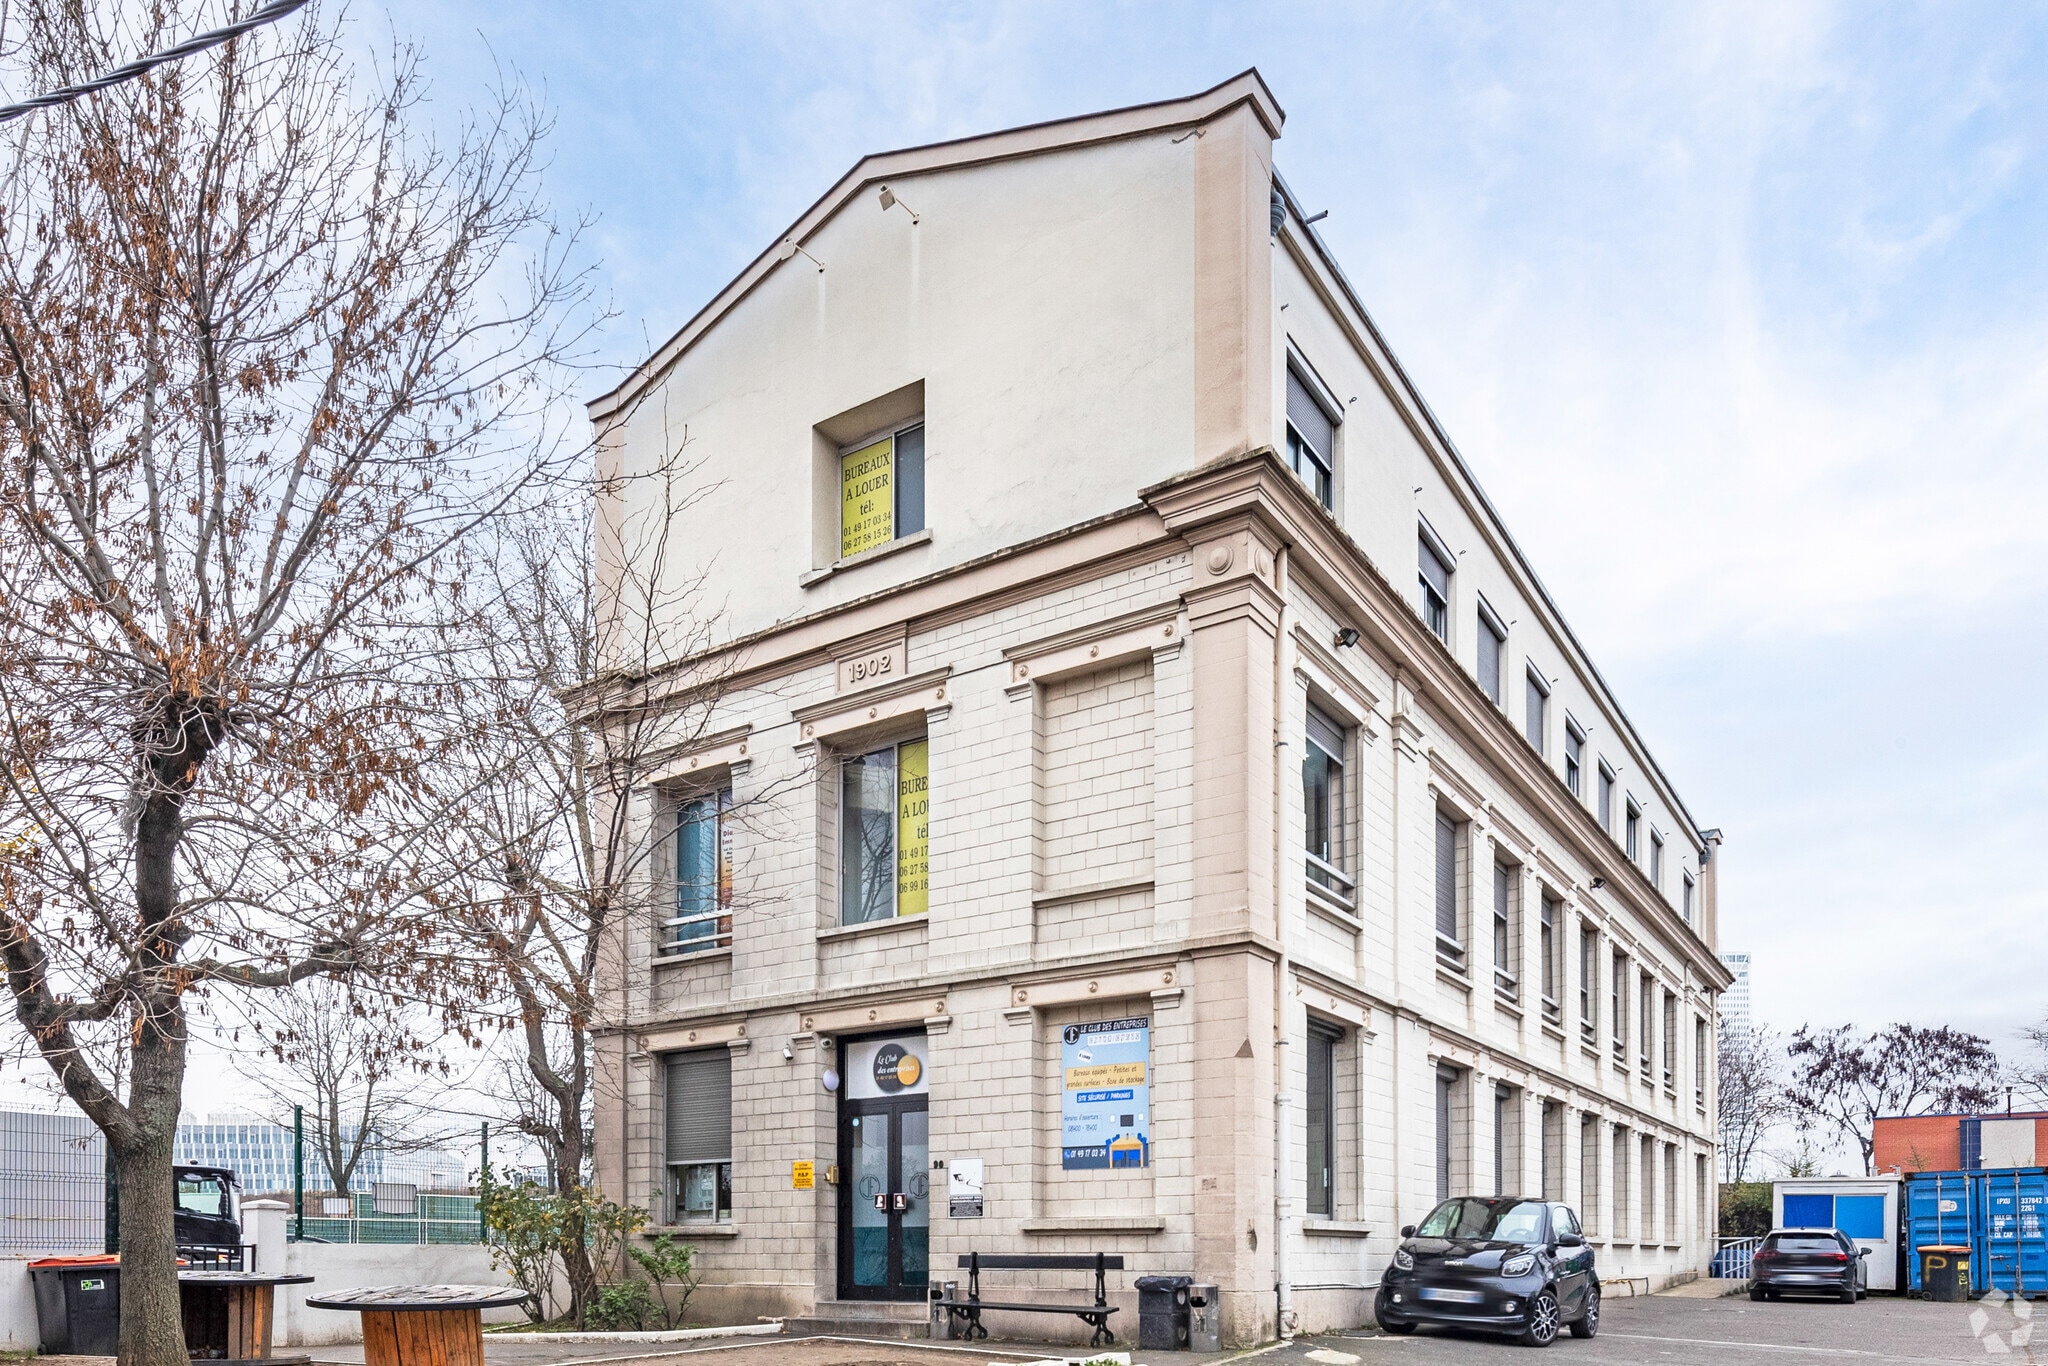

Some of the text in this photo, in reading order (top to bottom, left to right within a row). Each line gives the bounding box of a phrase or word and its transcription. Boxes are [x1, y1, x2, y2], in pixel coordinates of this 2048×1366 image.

[844, 452, 890, 482] BUREAUX
[846, 474, 888, 501] A LOUER
[844, 511, 891, 536] 01 49 17 03 34
[844, 540, 852, 550] 06
[853, 537, 861, 547] 27
[863, 532, 871, 543] 58
[874, 528, 881, 539] 15
[883, 525, 892, 535] 26
[848, 654, 891, 683] 1902
[902, 804, 910, 818] A
[900, 845, 928, 860] 01 49 17
[899, 862, 928, 877] 06 27 58
[899, 878, 928, 893] 06 99 16
[1080, 1019, 1147, 1033] LE CLUB DES ENTREPRISES
[877, 1054, 897, 1065] Le Club
[887, 1065, 915, 1073] entreprises
[1114, 1065, 1130, 1074] Petites
[1066, 1080, 1082, 1089] grandes
[1070, 1150, 1077, 1158] 01
[1091, 1149, 1098, 1157] 03
[1099, 1149, 1106, 1157] 34
[934, 1160, 944, 1169] 90
[1925, 1255, 1947, 1283] P
